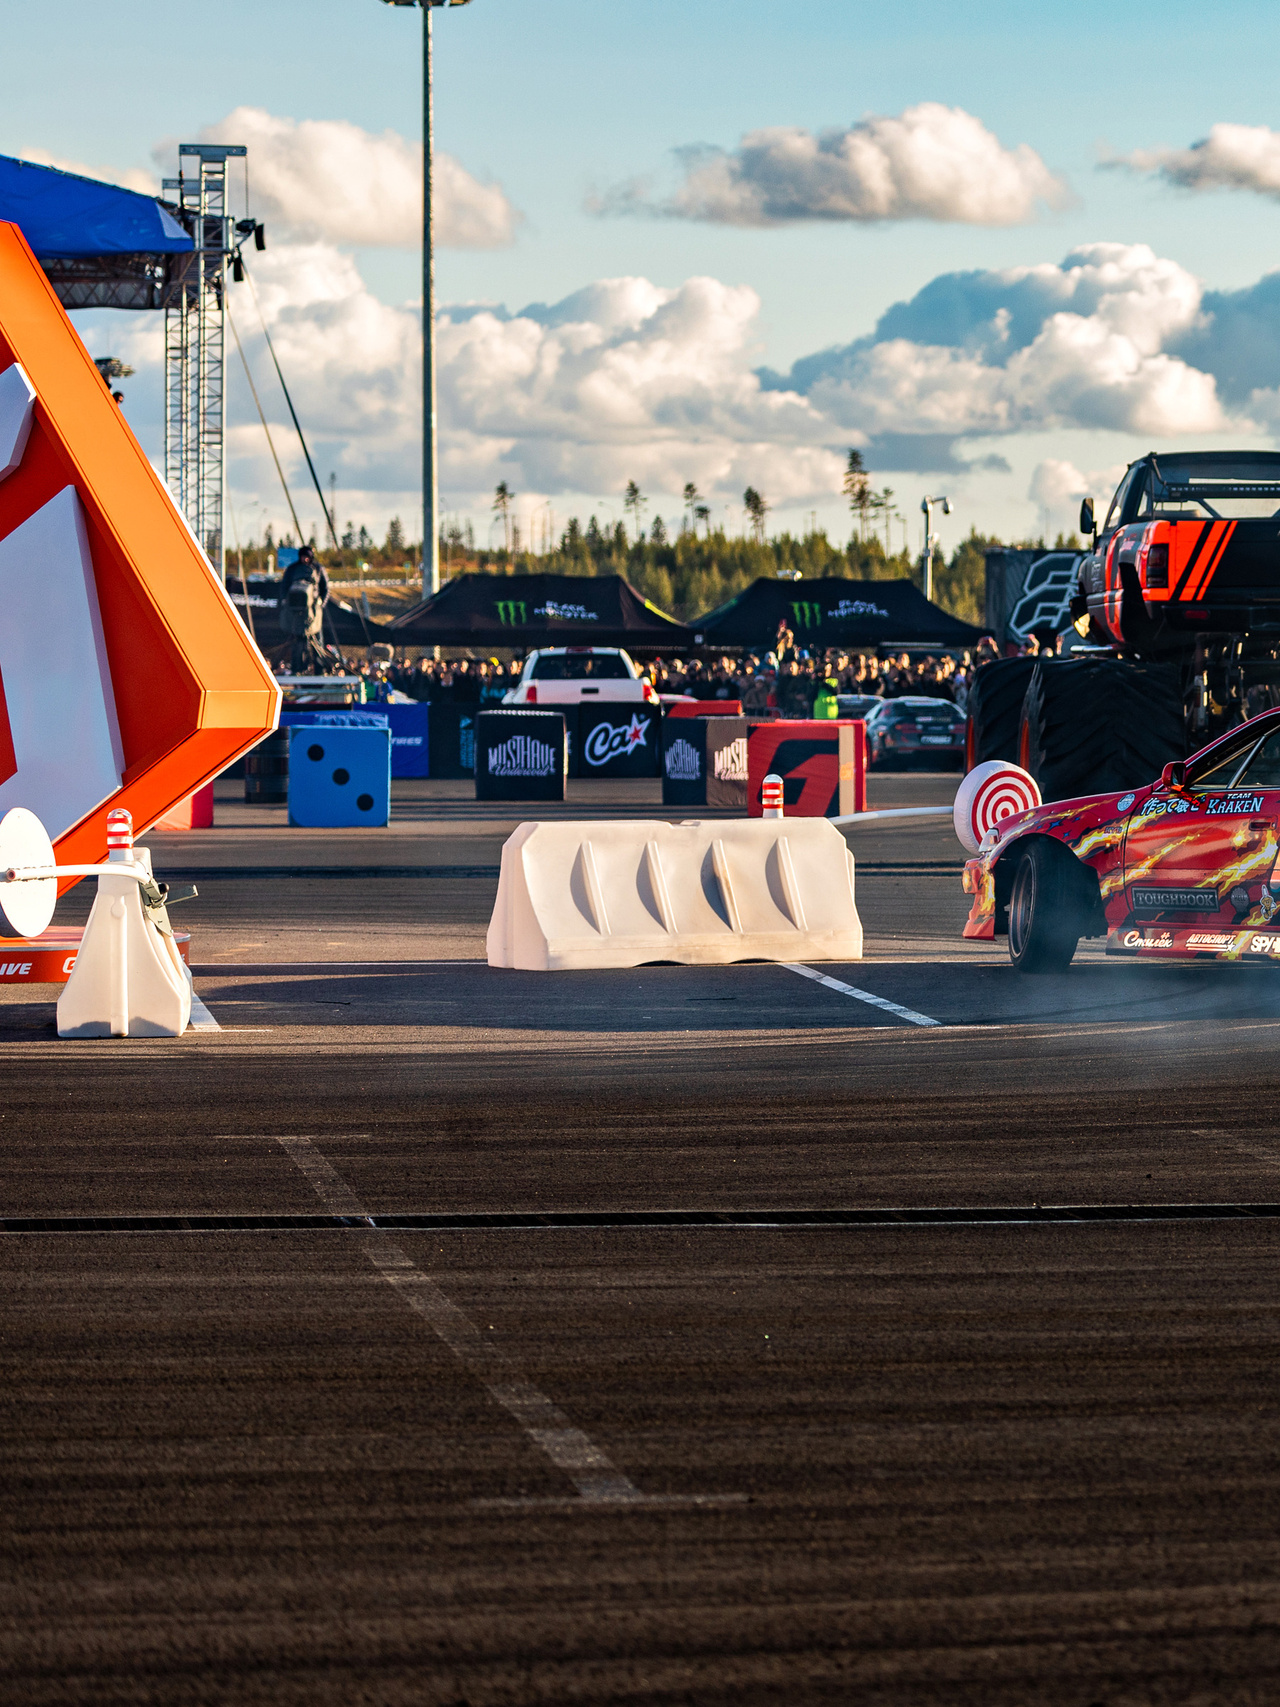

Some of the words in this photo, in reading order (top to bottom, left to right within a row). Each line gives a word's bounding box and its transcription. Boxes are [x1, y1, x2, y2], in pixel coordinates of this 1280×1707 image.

[1205, 797, 1264, 814] KRAKEN
[1136, 892, 1215, 906] TOUGHBOOK
[1186, 933, 1237, 944] АВТОСПОРТ
